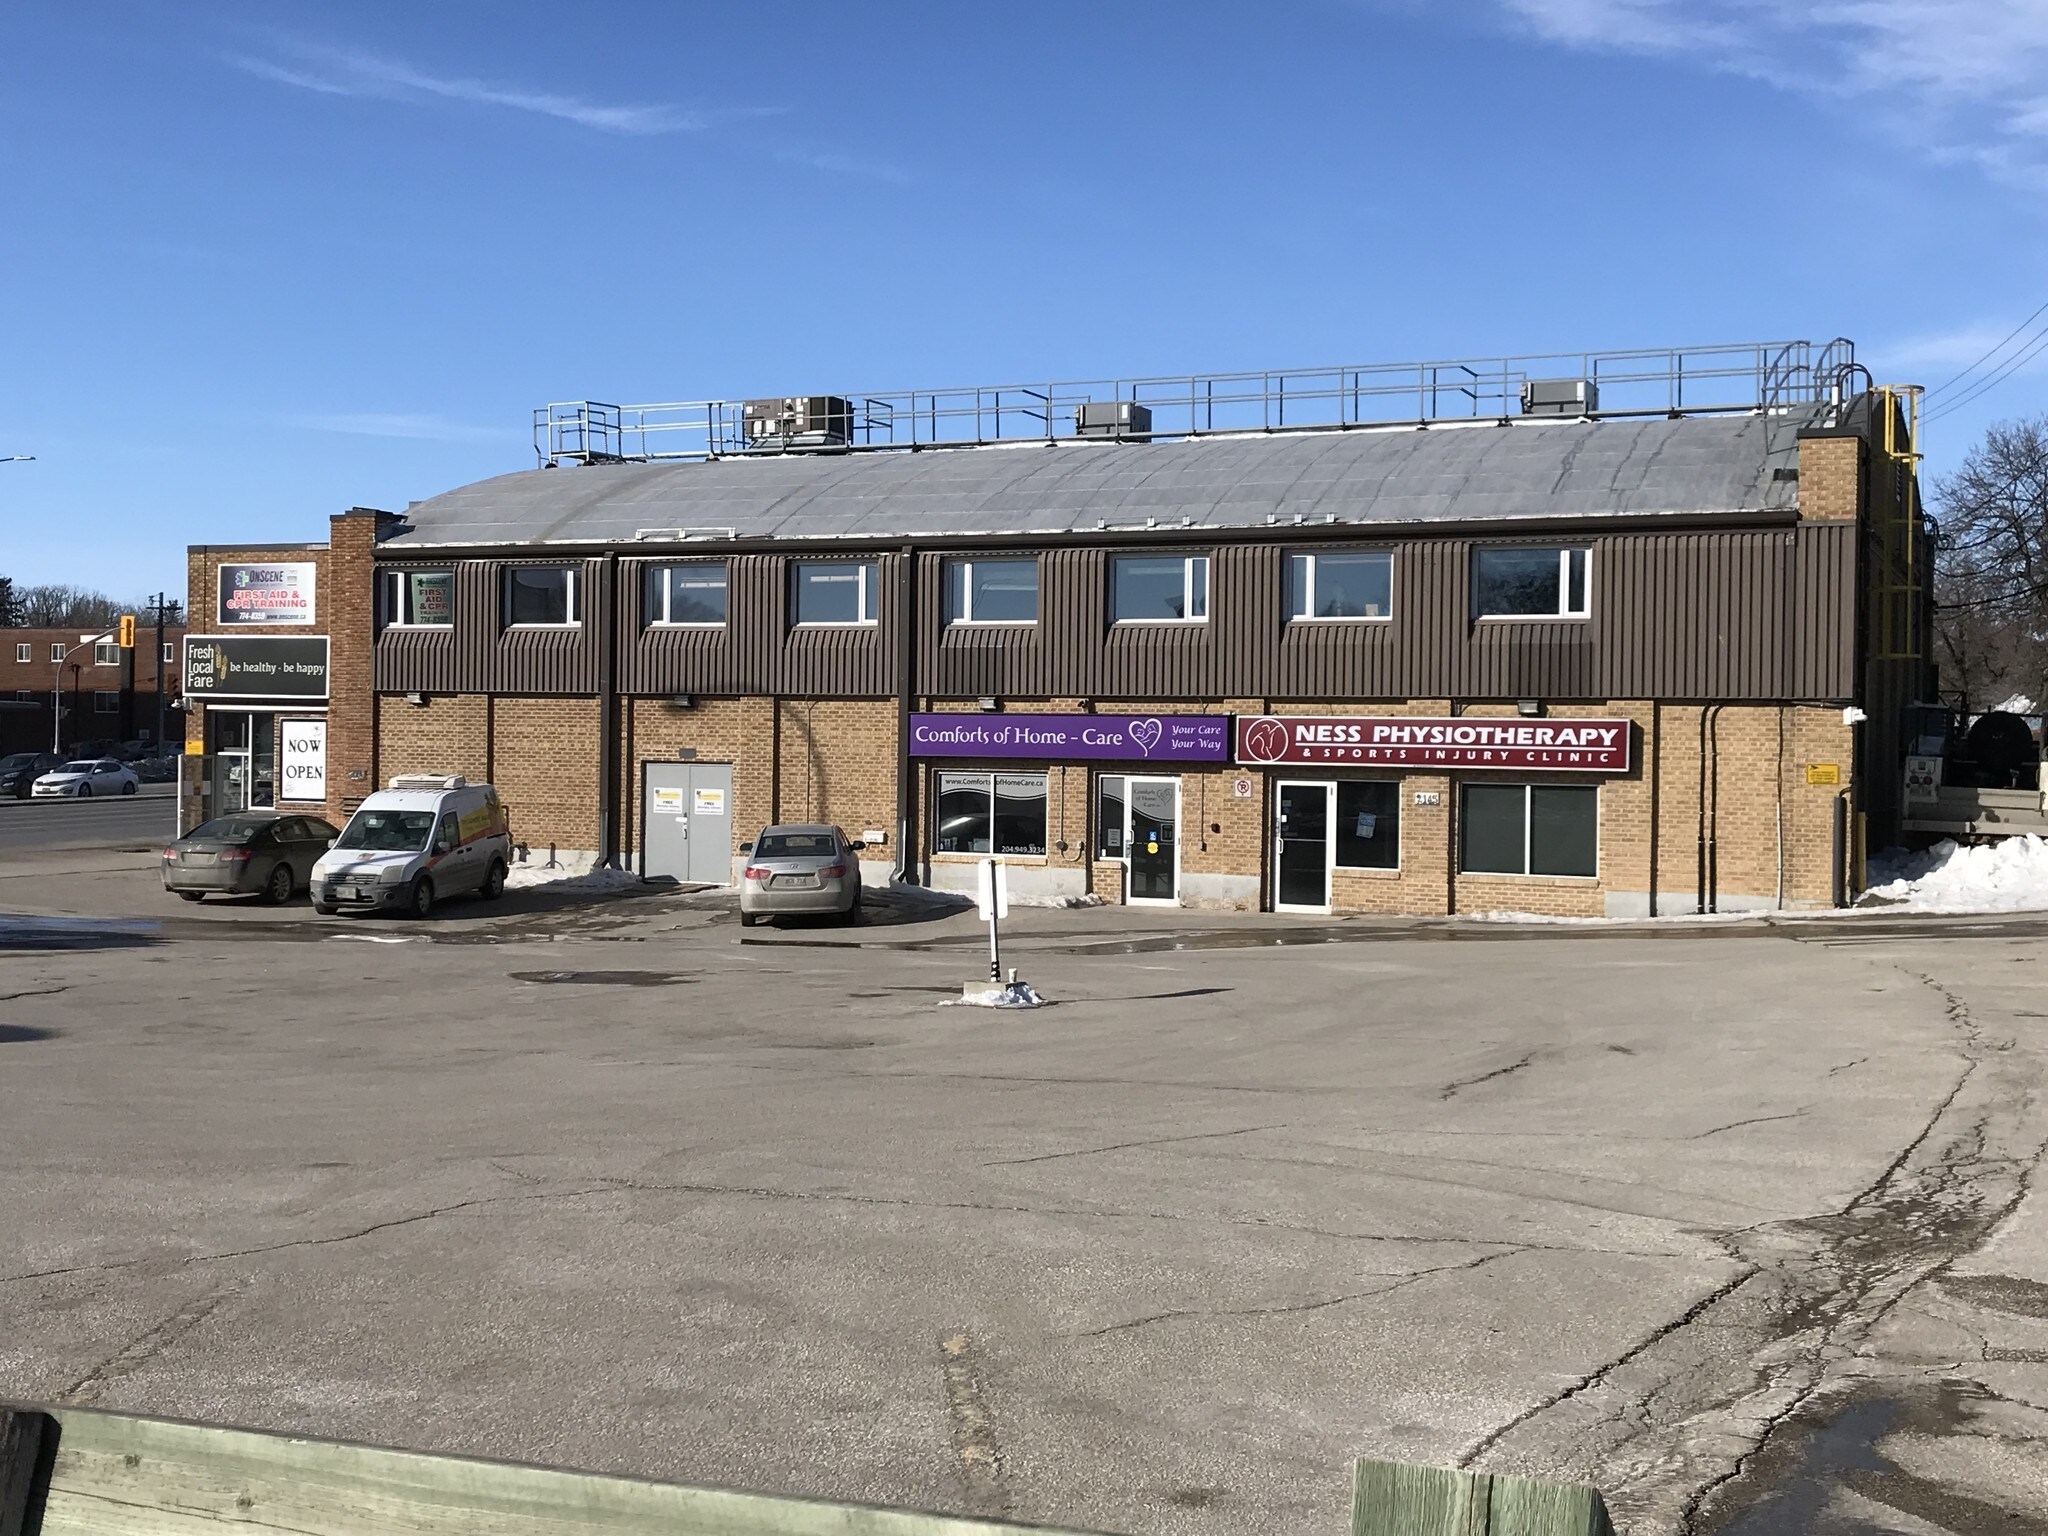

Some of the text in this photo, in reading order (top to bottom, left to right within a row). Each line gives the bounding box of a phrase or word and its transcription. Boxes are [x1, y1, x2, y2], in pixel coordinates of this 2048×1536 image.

[234, 590, 300, 599] FIRST AID &
[419, 588, 447, 596] FIRST
[227, 600, 307, 609] CPR TRAINING
[189, 644, 214, 659] Fresh
[189, 659, 214, 674] Local
[230, 662, 241, 672] be
[243, 662, 277, 675] healthy
[283, 662, 295, 672] be
[296, 663, 325, 676] happy
[188, 674, 214, 688] Fare
[916, 726, 989, 745] Comforts
[994, 728, 1010, 745] of
[1014, 728, 1066, 745] Home
[1082, 728, 1123, 746] Care
[1172, 724, 1222, 736] Your Care
[1296, 725, 1618, 746] NESS PHYSIOTHERAPY
[288, 739, 321, 753] NOW
[1171, 738, 1222, 752] Your Way
[1303, 748, 1610, 762] & SPORTS INJURY CLINIC
[286, 765, 322, 780] OPEN
[1417, 794, 1438, 804] 2145
